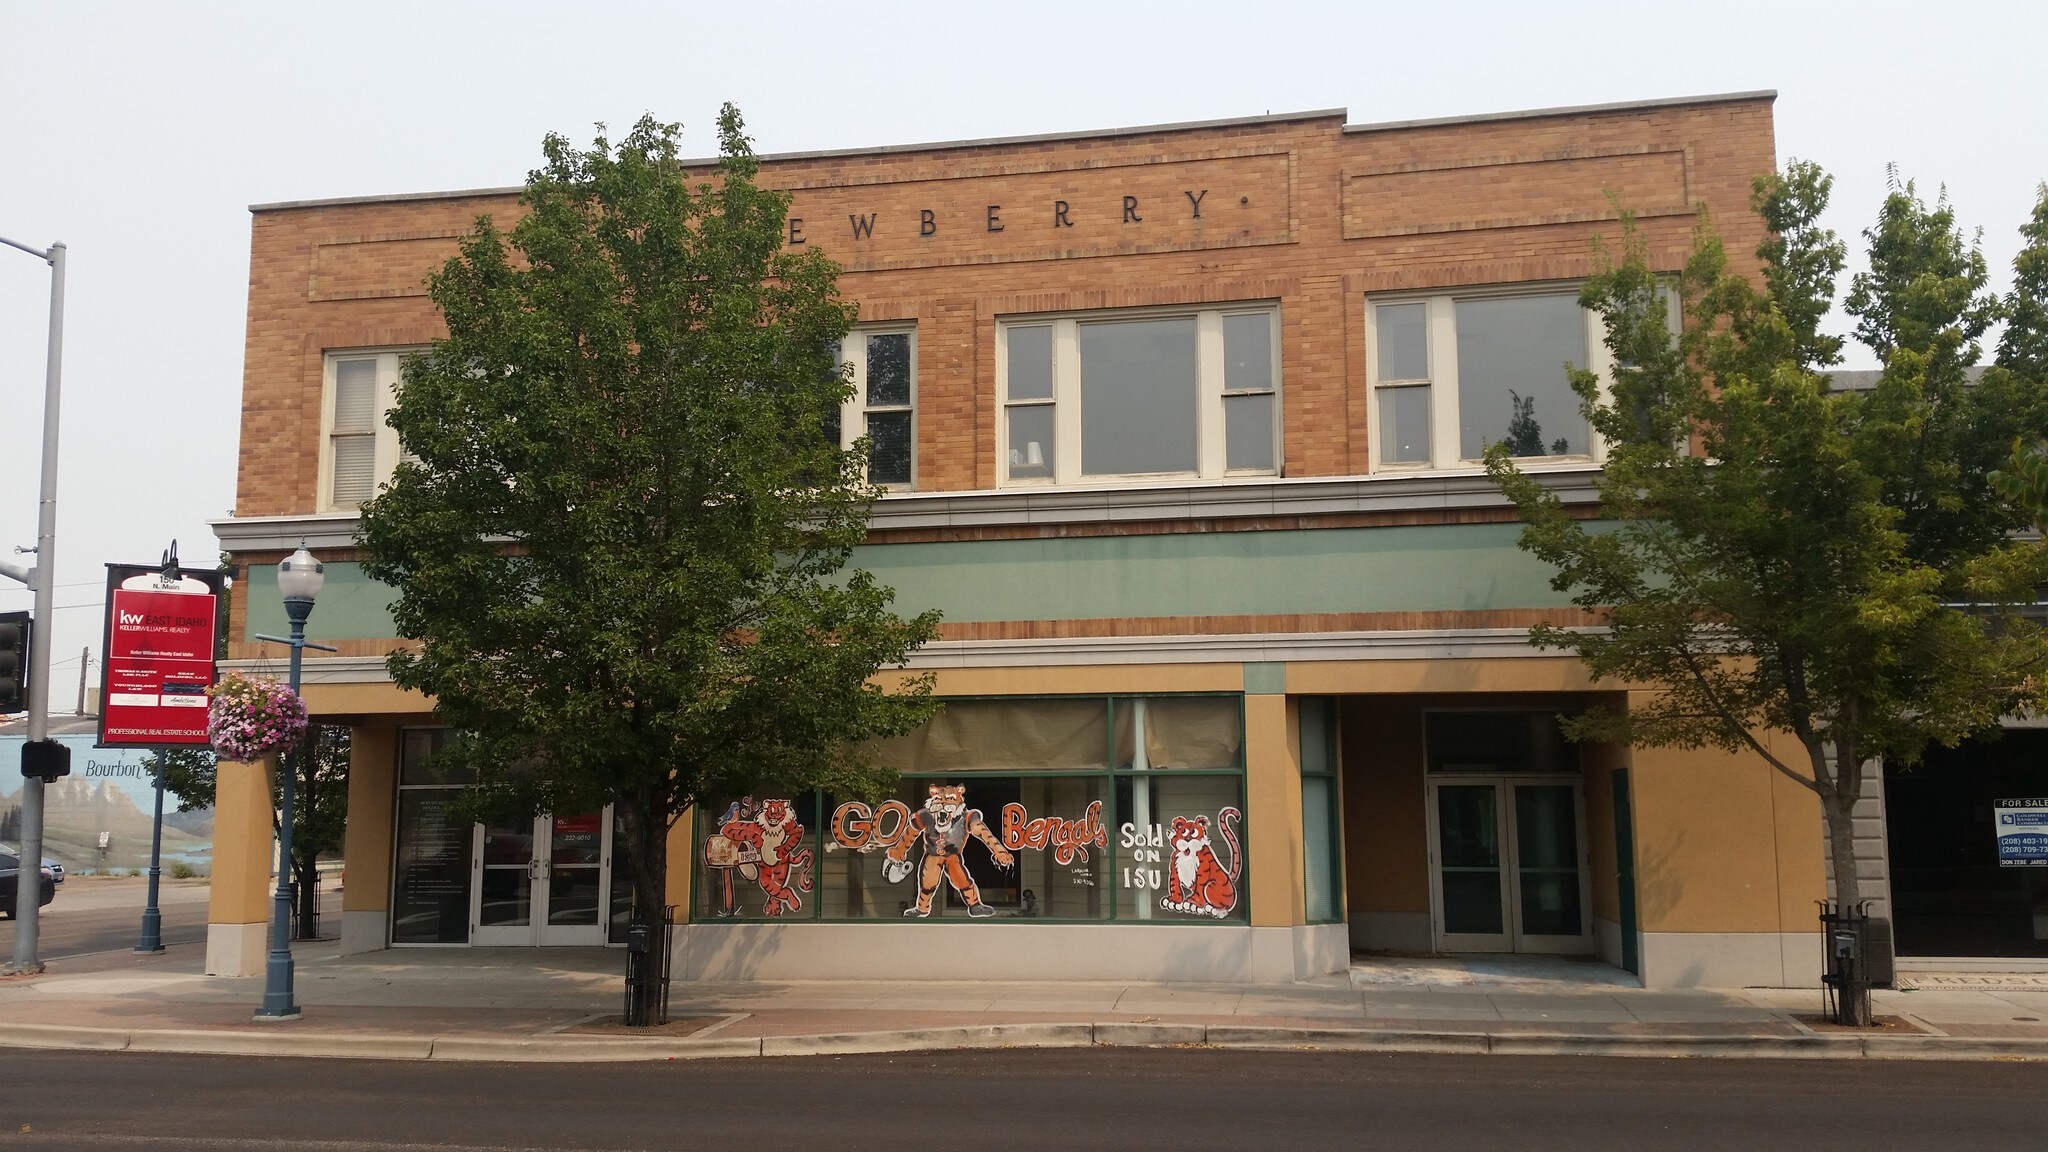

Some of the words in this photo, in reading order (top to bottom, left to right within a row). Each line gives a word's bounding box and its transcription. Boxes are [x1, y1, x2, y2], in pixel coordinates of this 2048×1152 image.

[788, 189, 1208, 244] EWBERRY
[120, 609, 144, 625] kw
[146, 615, 172, 626] EAST
[175, 616, 208, 628] IDAHO
[85, 760, 141, 779] Bourbon
[831, 800, 911, 849] GO
[1002, 800, 1107, 864] Bengals
[1121, 822, 1164, 849] Sold
[2001, 837, 2021, 846] (208)
[1133, 849, 1161, 863] ON
[2002, 846, 2022, 855] (208)
[1123, 867, 1161, 890] ISU
